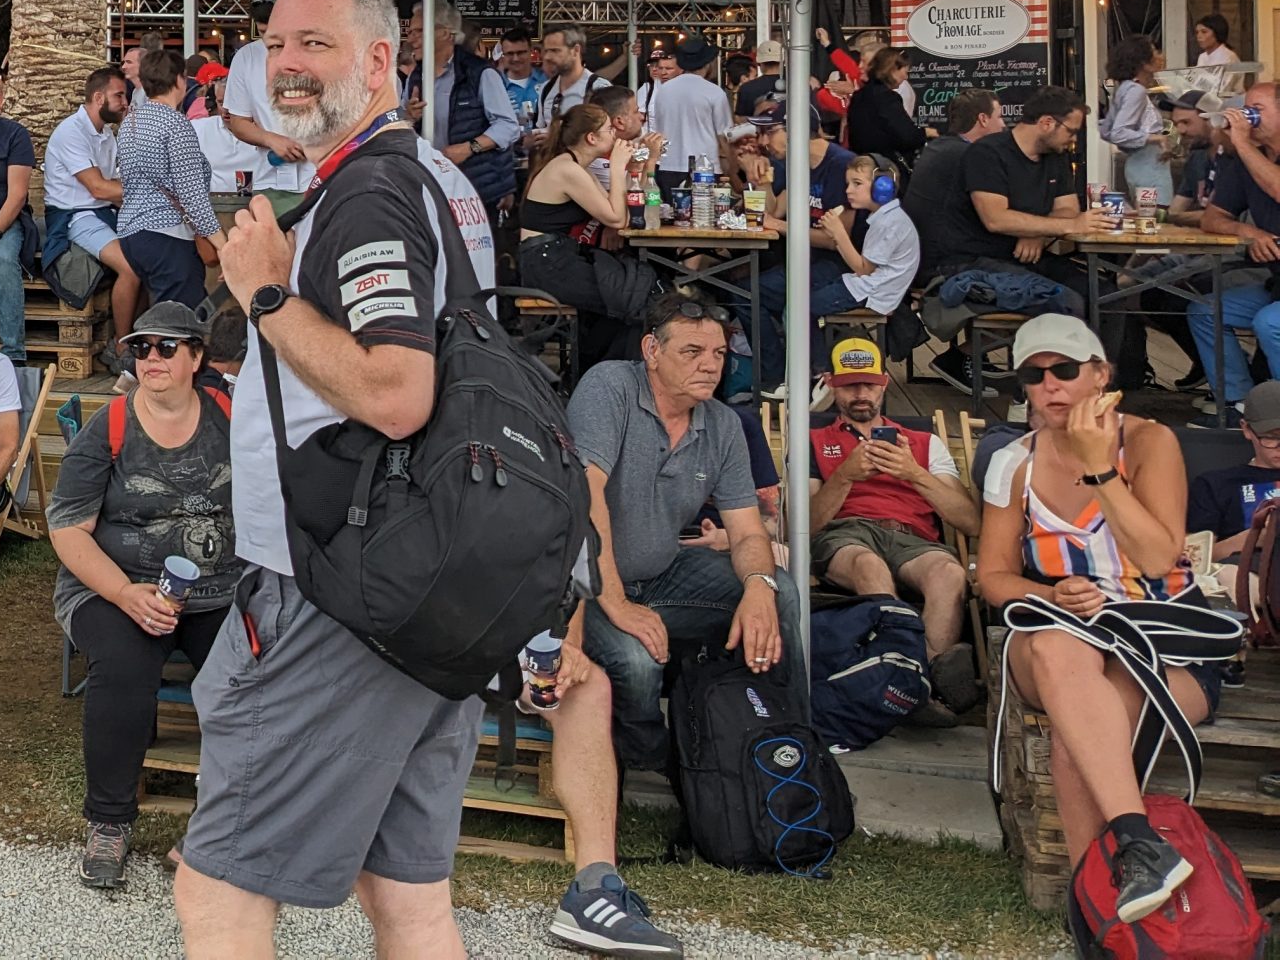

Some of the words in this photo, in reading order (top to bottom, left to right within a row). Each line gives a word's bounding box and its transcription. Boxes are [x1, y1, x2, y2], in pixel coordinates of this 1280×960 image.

[928, 5, 1006, 25] CHARCUTERIE
[936, 21, 983, 39] FROMAGE
[918, 105, 945, 117] BLANC
[354, 251, 377, 263] AISIN
[379, 248, 394, 257] AW
[354, 273, 390, 294] ZENT
[363, 302, 405, 314] MICHELIN
[887, 684, 919, 705] WILLIAMS
[883, 700, 910, 716] RACING
